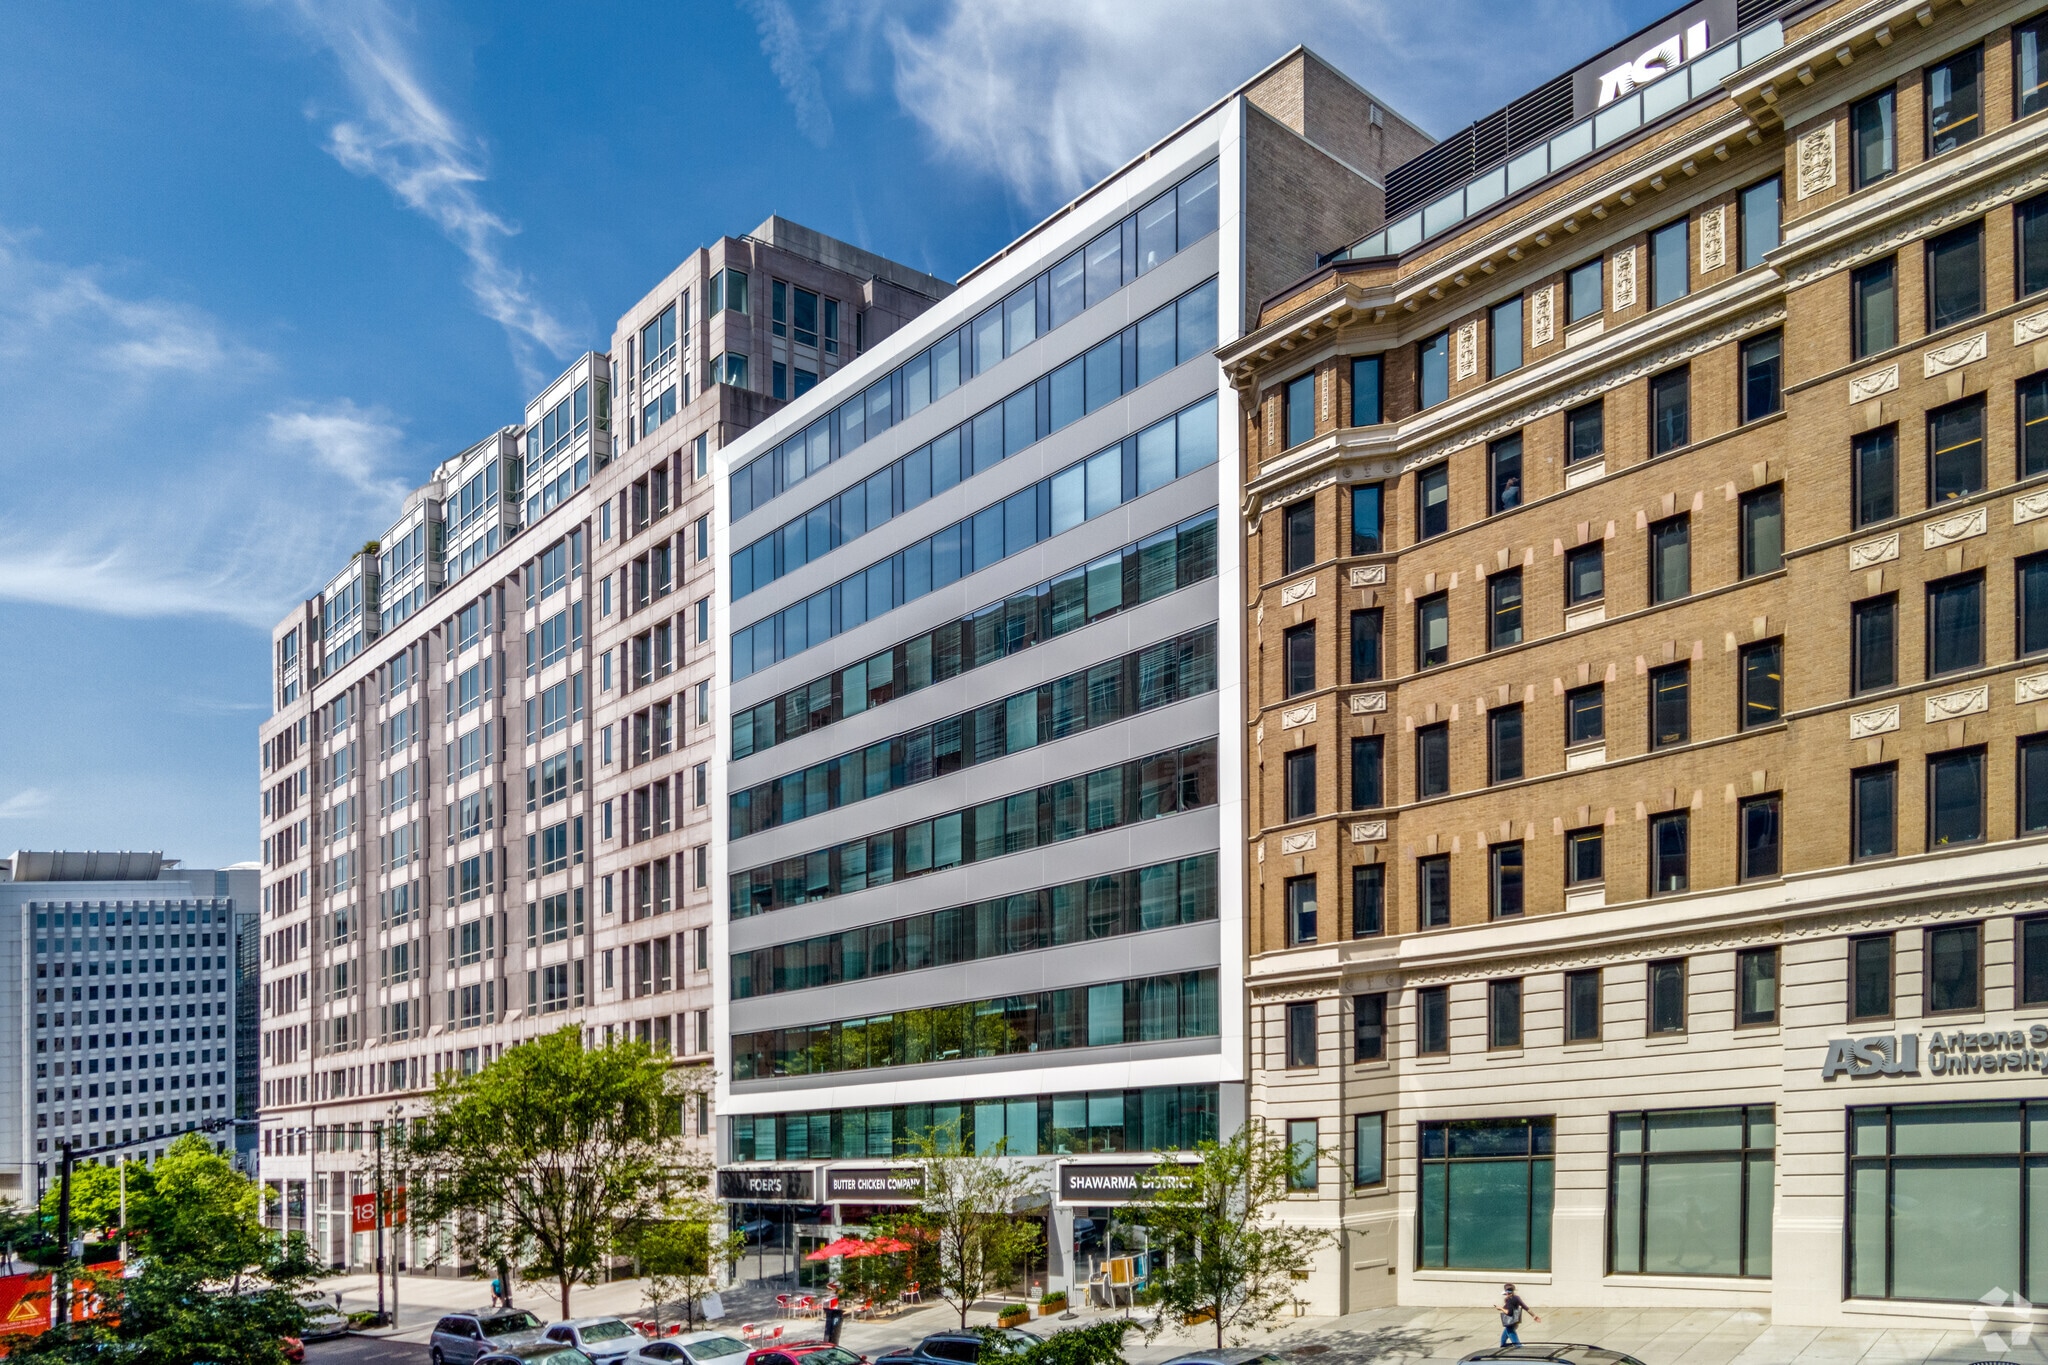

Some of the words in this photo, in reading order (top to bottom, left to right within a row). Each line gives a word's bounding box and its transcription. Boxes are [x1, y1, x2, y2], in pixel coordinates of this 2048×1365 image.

[1928, 1030, 2023, 1049] Arizona
[1822, 1033, 1918, 1078] ASU
[1928, 1047, 2048, 1070] University
[750, 1178, 782, 1192] FOER'S
[833, 1179, 856, 1190] BUTTER
[858, 1179, 886, 1190] CHICKEN
[887, 1178, 920, 1190] COMPANY
[1070, 1176, 1137, 1189] SHAWARMA
[354, 1203, 374, 1220] 18
